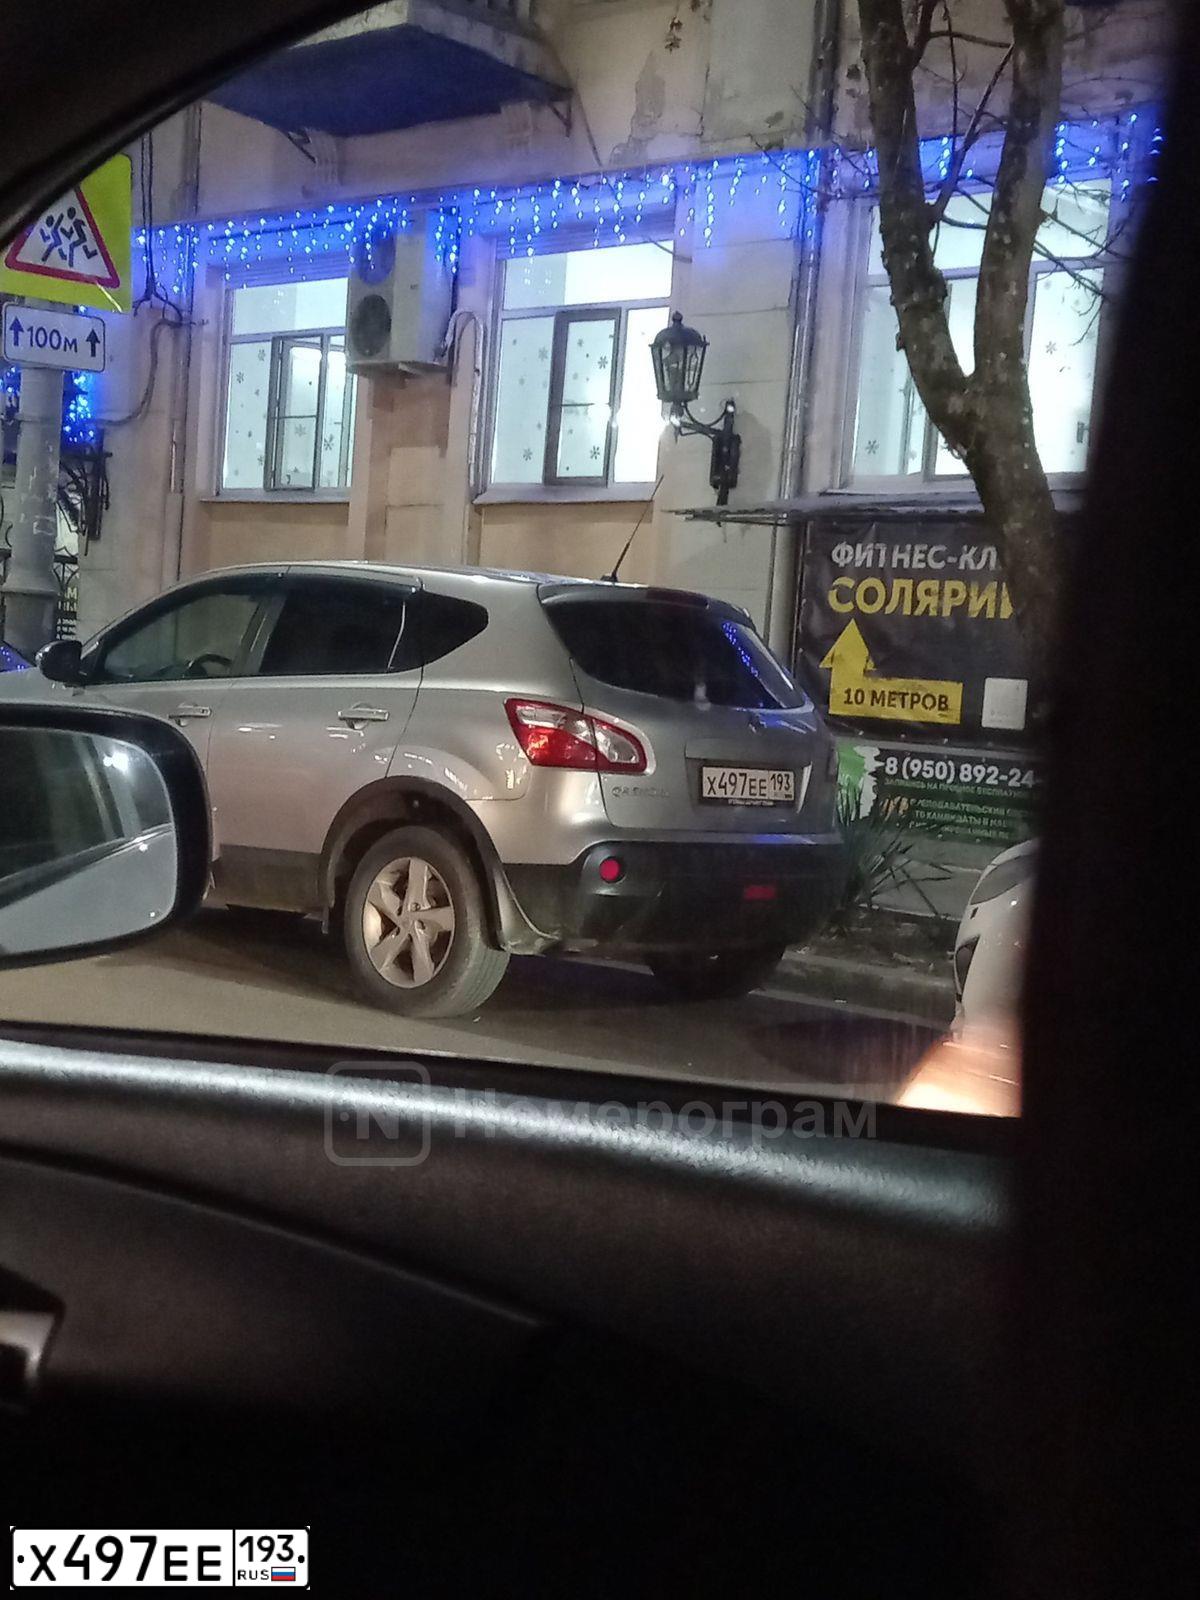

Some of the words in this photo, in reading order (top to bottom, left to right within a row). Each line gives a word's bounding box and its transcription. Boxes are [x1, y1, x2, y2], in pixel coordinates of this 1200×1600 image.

[831, 541, 1001, 570] ФИТНЕС-КЛ
[843, 688, 865, 705] 10
[870, 689, 949, 712] МЕТРОВ
[770, 773, 791, 791] 193
[885, 756, 898, 775] 8
[902, 756, 955, 784] (950)
